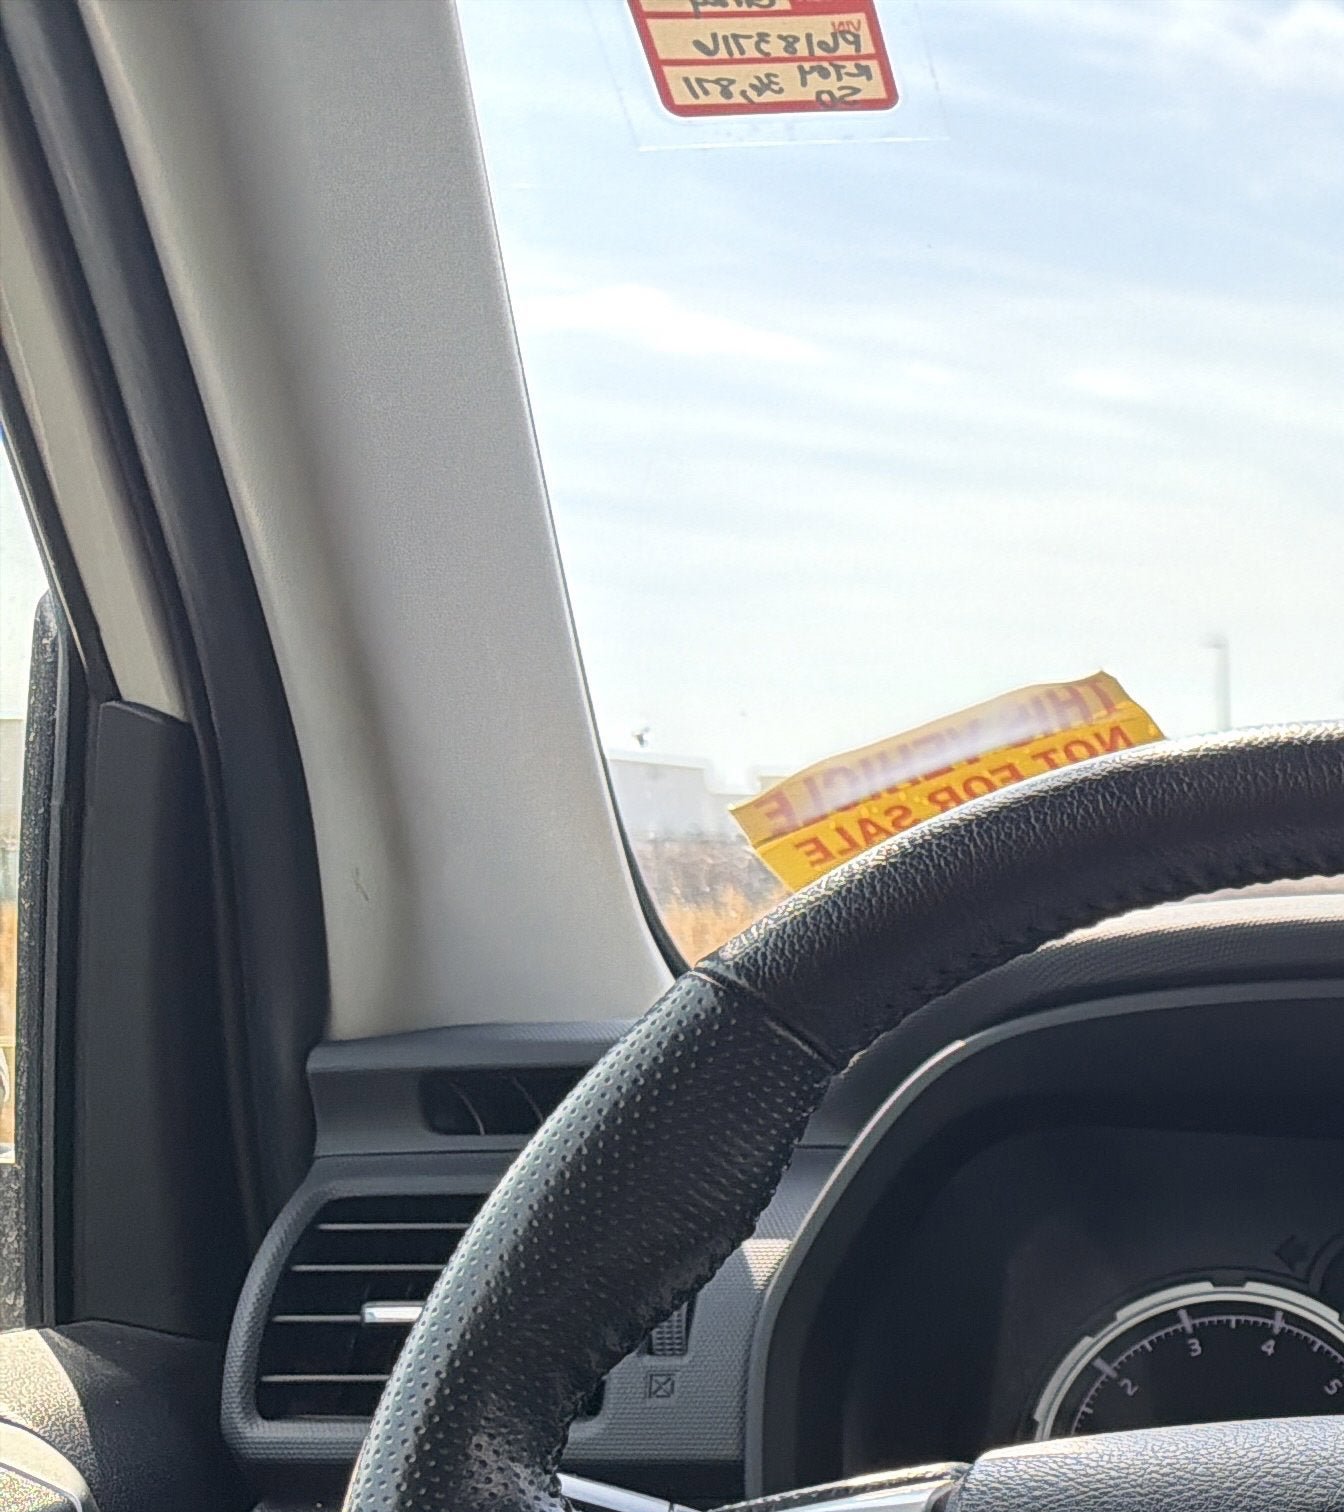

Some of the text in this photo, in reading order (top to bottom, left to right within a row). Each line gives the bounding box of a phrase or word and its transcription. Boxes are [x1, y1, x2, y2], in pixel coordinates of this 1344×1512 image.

[1189, 1339, 1202, 1356] 3
[1261, 1340, 1275, 1356] 4
[1120, 1378, 1138, 1396] 2
[1324, 1379, 1342, 1396] 5
